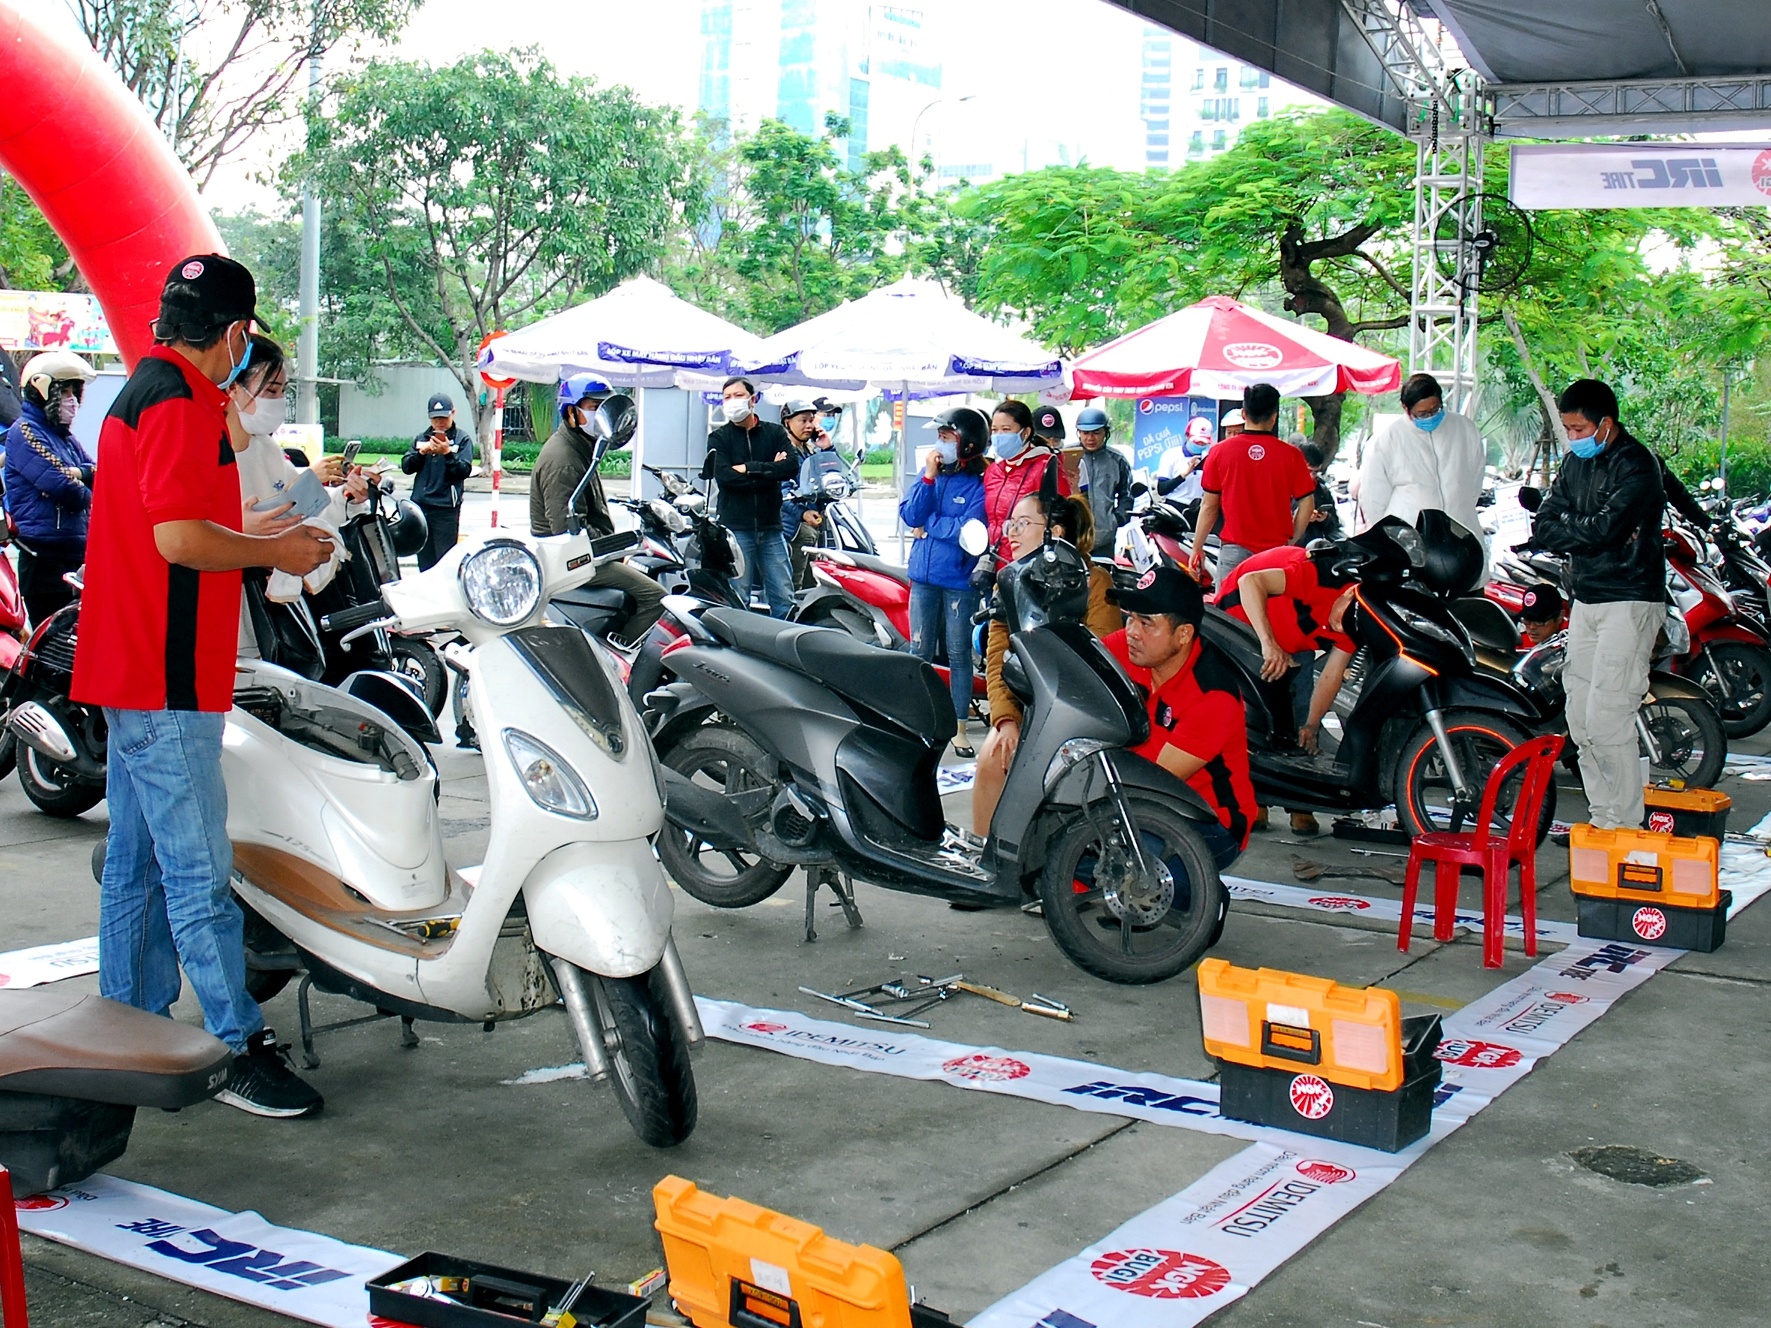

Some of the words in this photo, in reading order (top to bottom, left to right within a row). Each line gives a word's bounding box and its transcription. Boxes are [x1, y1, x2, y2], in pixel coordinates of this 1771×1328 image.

[1154, 402, 1184, 414] pepsi
[1137, 441, 1163, 460] PEPSI
[1638, 912, 1659, 923] NGK
[1505, 1001, 1567, 1035] IDEMITSU
[785, 1029, 907, 1055] IDEMITSU
[207, 1067, 228, 1090] SYM
[1295, 1084, 1325, 1095] NGK
[1221, 1180, 1322, 1238] IDEMITSU
[115, 1217, 187, 1239] TIRE
[1106, 1253, 1161, 1282] BUGI
[1149, 1260, 1213, 1294] NGK
